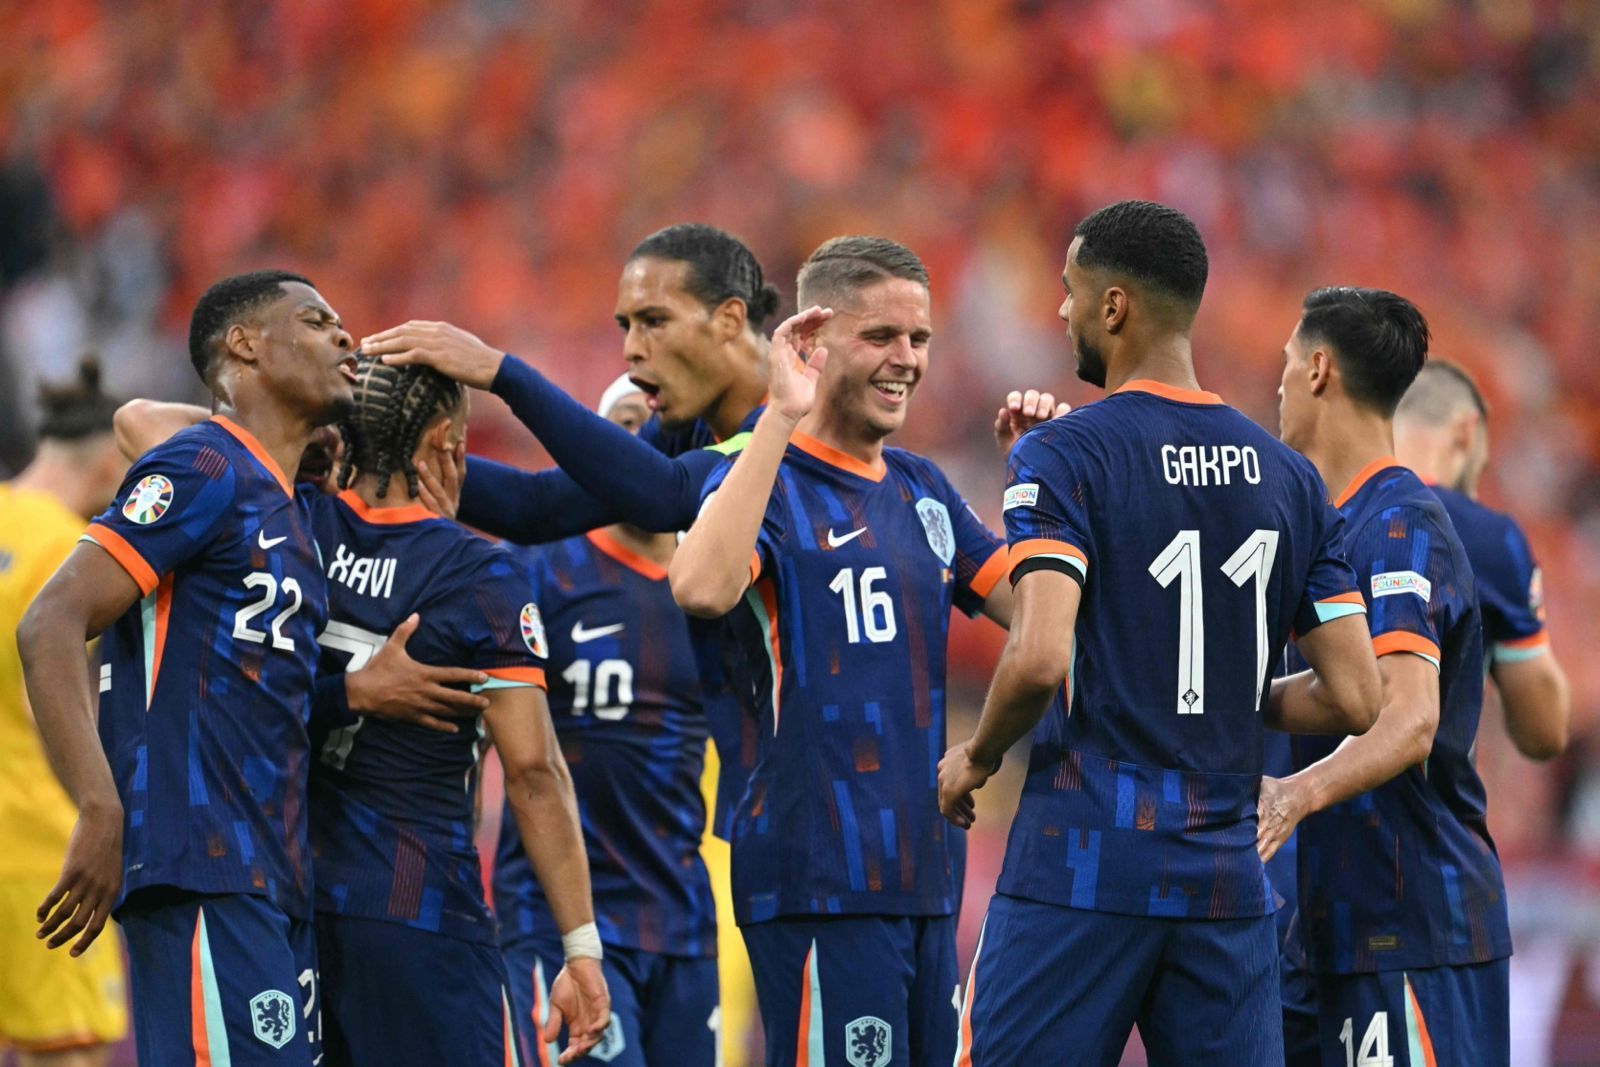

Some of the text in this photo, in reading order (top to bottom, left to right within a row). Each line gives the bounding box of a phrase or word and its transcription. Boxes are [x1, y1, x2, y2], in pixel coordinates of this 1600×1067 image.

[1161, 444, 1262, 486] GAKPO
[328, 544, 397, 598] XAVI
[233, 572, 303, 652] 22
[829, 566, 898, 643] 16
[1148, 529, 1279, 714] 11
[562, 659, 634, 720] 10
[1339, 1011, 1394, 1067] 14
